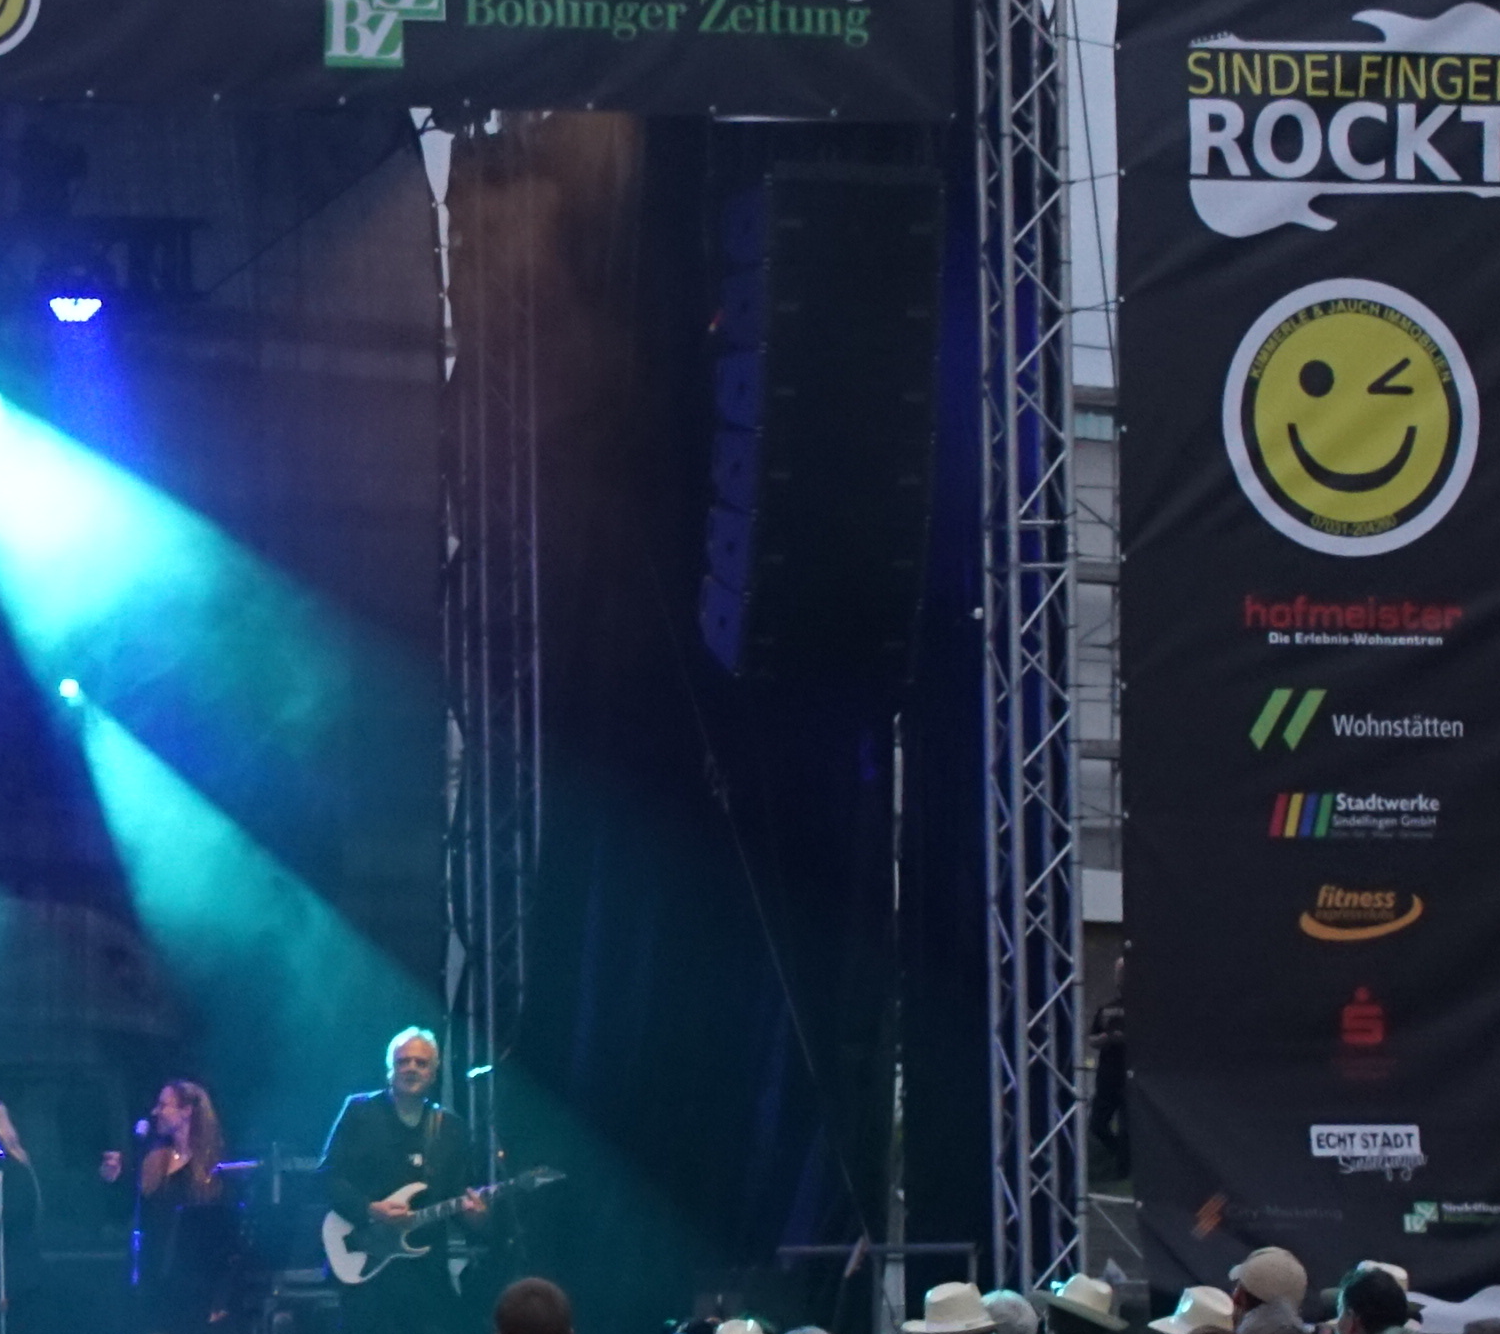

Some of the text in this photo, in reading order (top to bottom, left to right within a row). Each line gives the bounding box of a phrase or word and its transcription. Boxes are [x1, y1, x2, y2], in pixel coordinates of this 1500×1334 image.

[1250, 310, 1309, 378] KIMMERLE
[1329, 299, 1380, 315] JAUCH
[1382, 308, 1452, 383] IMMOBILIEN
[1244, 593, 1463, 632] hofmeister
[1267, 631, 1444, 647] Die Erlebnis-Wohnzentren
[1331, 710, 1465, 739] Wohnstätten
[1335, 792, 1440, 812] Stadtwerke
[1332, 814, 1437, 830] Sindelfingen GmbH
[1316, 883, 1397, 909] fitness
[1315, 1131, 1415, 1150] ECHT STADT
